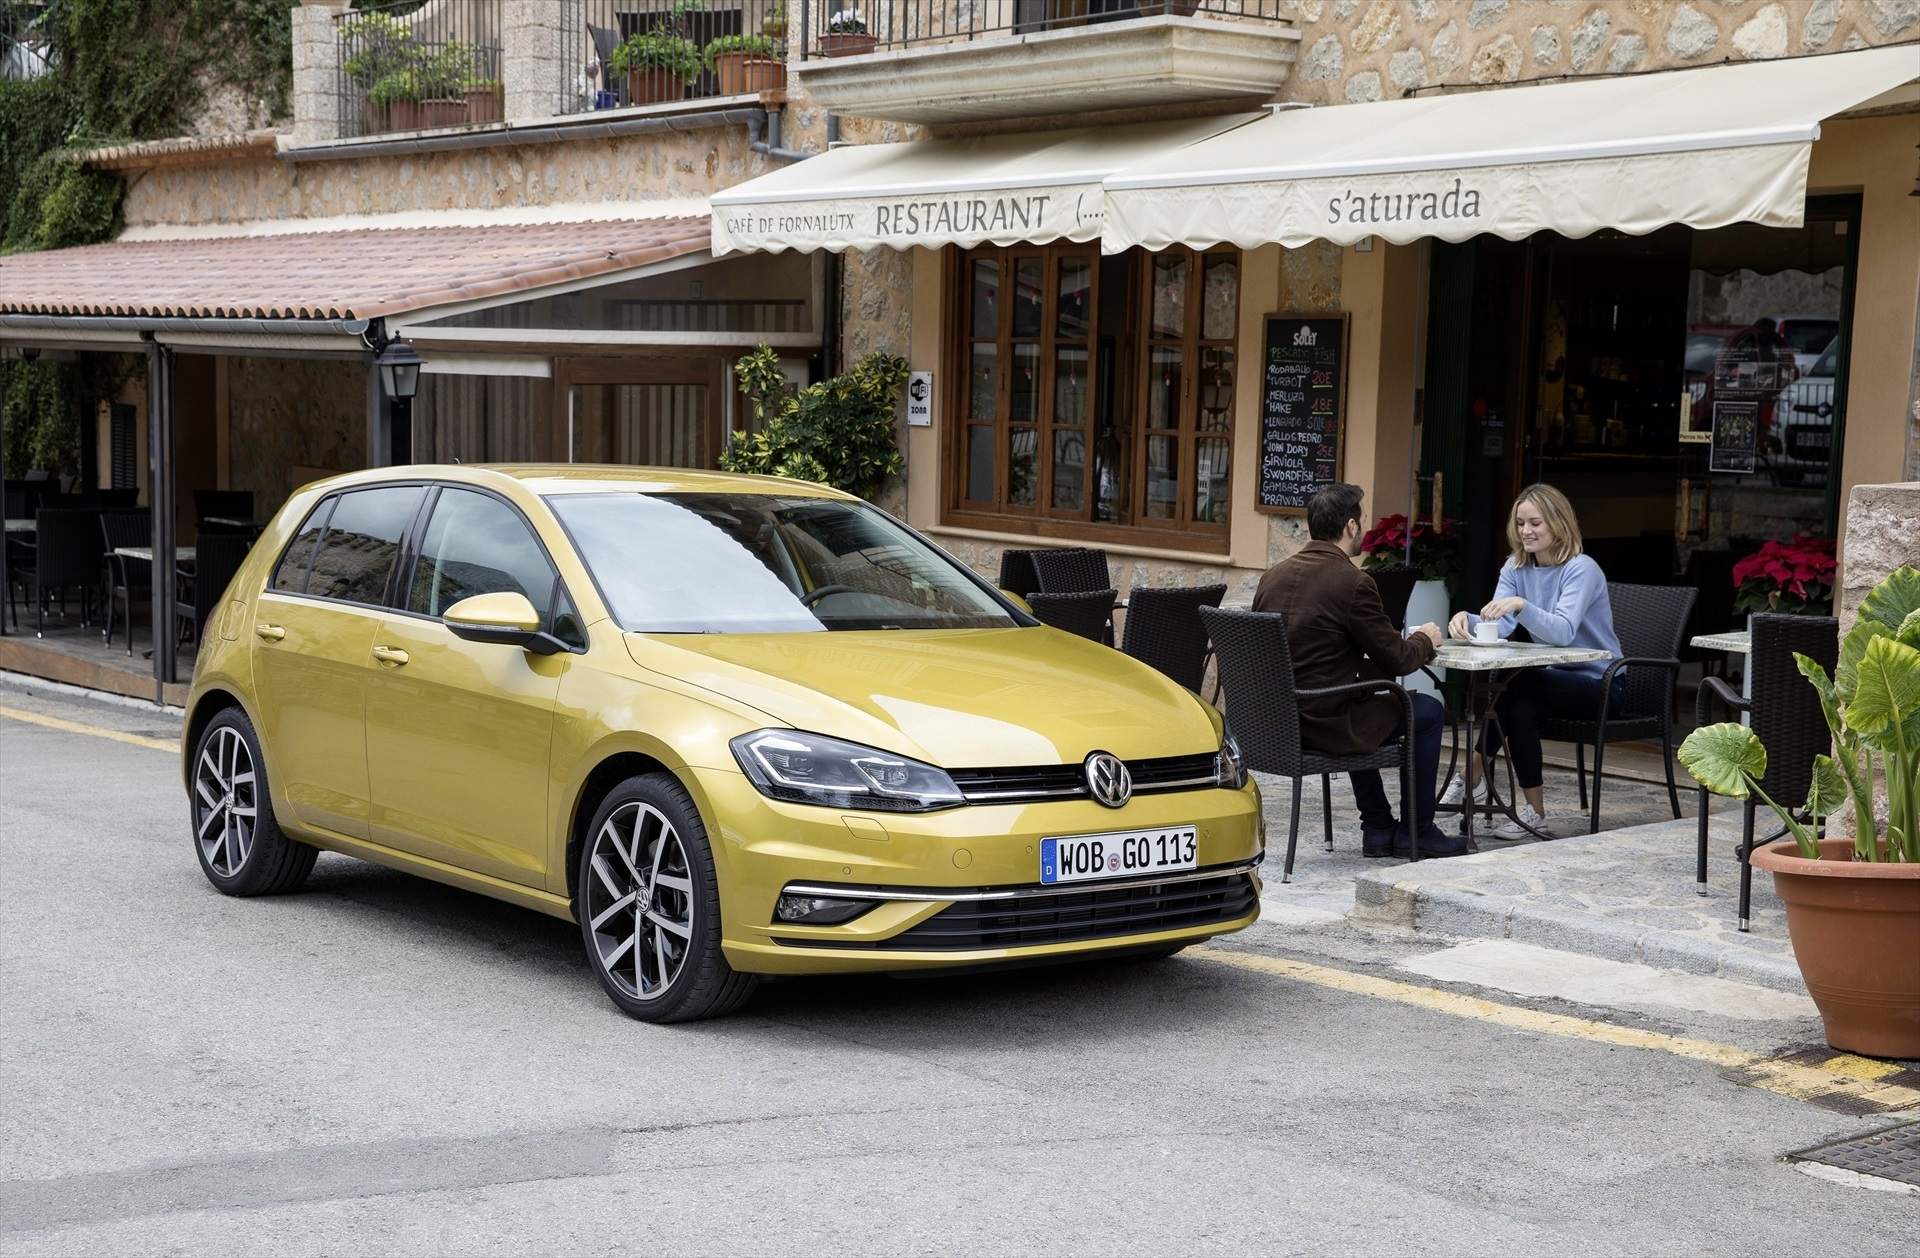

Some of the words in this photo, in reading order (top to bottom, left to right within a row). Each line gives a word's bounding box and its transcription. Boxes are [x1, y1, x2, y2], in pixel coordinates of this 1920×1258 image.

[1328, 178, 1481, 225] s'aturada
[759, 216, 774, 232] DE
[778, 213, 854, 232] FORNALUTX
[876, 195, 1051, 236] RESTAURANT
[1270, 375, 1307, 388] TURBOT
[1269, 390, 1304, 402] MERLUZA
[1268, 402, 1292, 414] HAKE
[1297, 432, 1322, 444] PEDRO
[1266, 441, 1285, 452] JOHN
[1286, 443, 1309, 457] DORY
[1263, 468, 1314, 482] SWORDFISH
[1263, 480, 1299, 494] GAMBAS
[1263, 494, 1305, 507] PRAWNS
[1046, 865, 1053, 875] D
[1060, 841, 1105, 876] WOB
[1123, 837, 1151, 869] GO
[1156, 832, 1195, 867] 113
